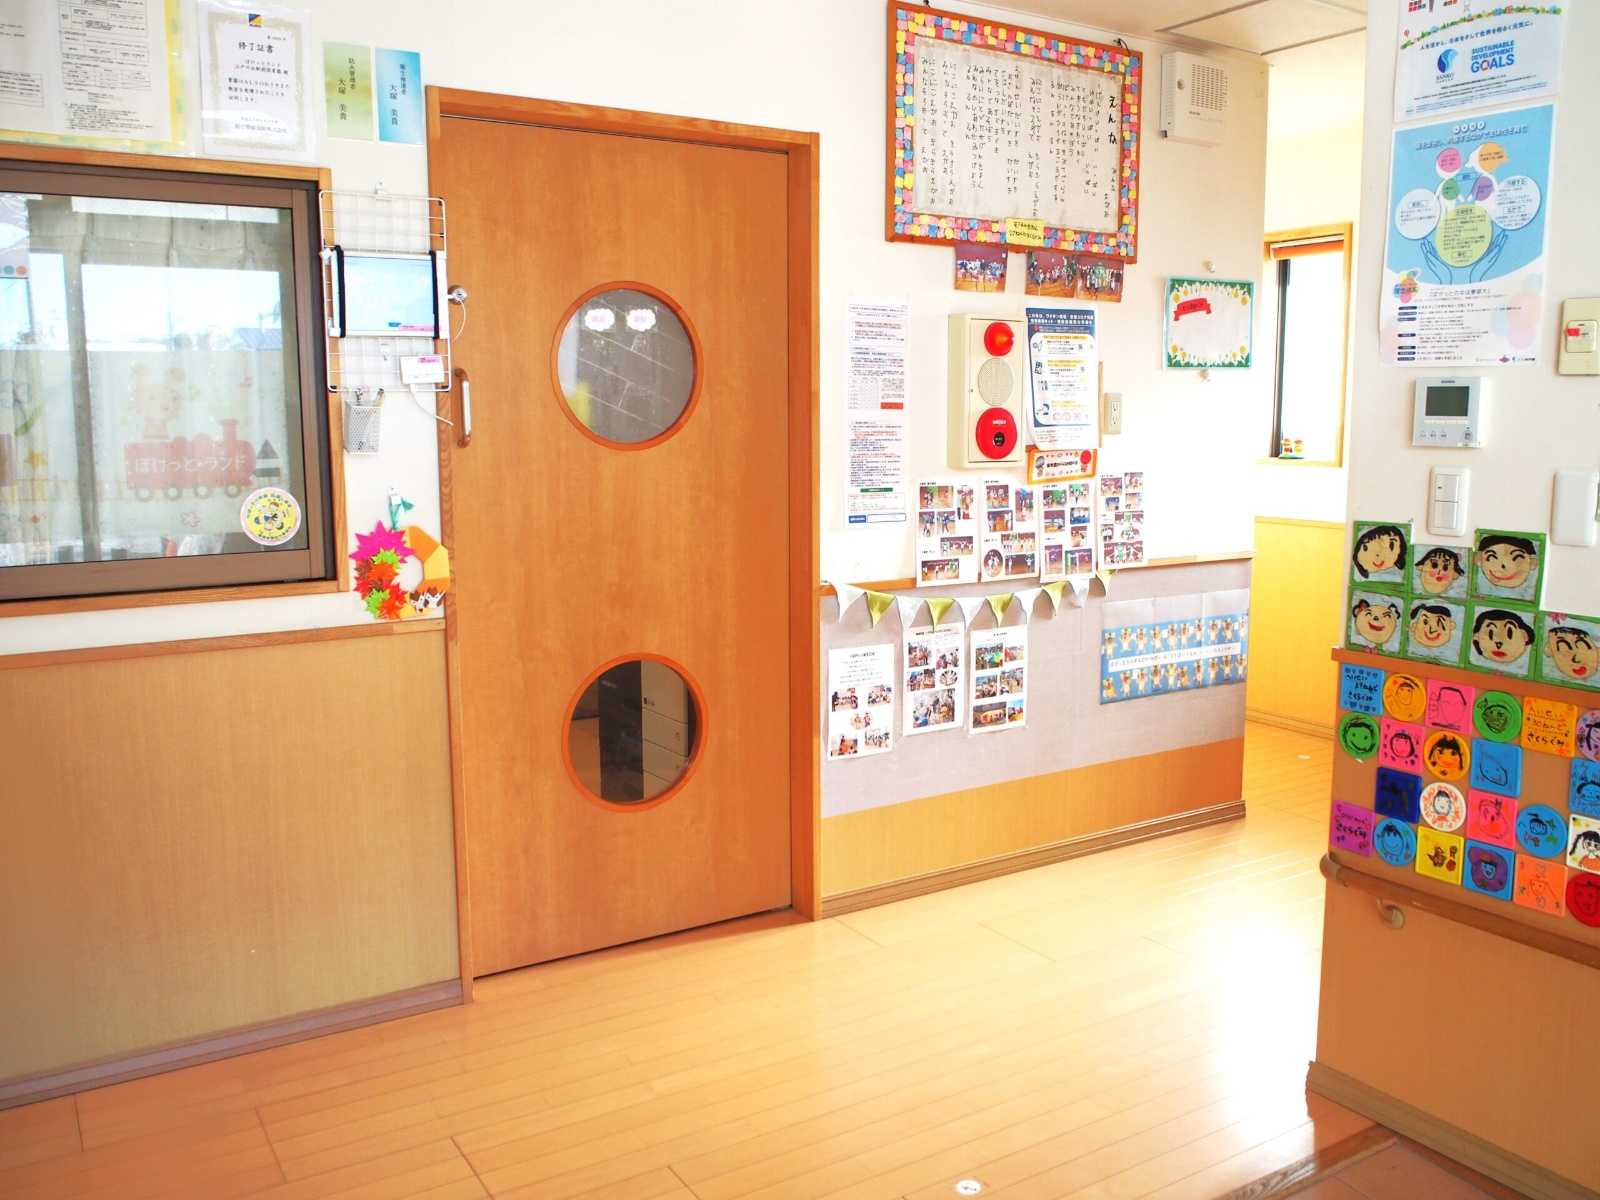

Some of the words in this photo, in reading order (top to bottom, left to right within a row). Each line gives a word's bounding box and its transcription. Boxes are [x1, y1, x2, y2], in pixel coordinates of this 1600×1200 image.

[238, 41, 275, 54] 修了証書
[1471, 39, 1515, 54] SUSTAINABLE
[1471, 47, 1514, 61] DEVELOPMENT
[1471, 54, 1515, 73] GOALS
[1108, 95, 1118, 145] えんか
